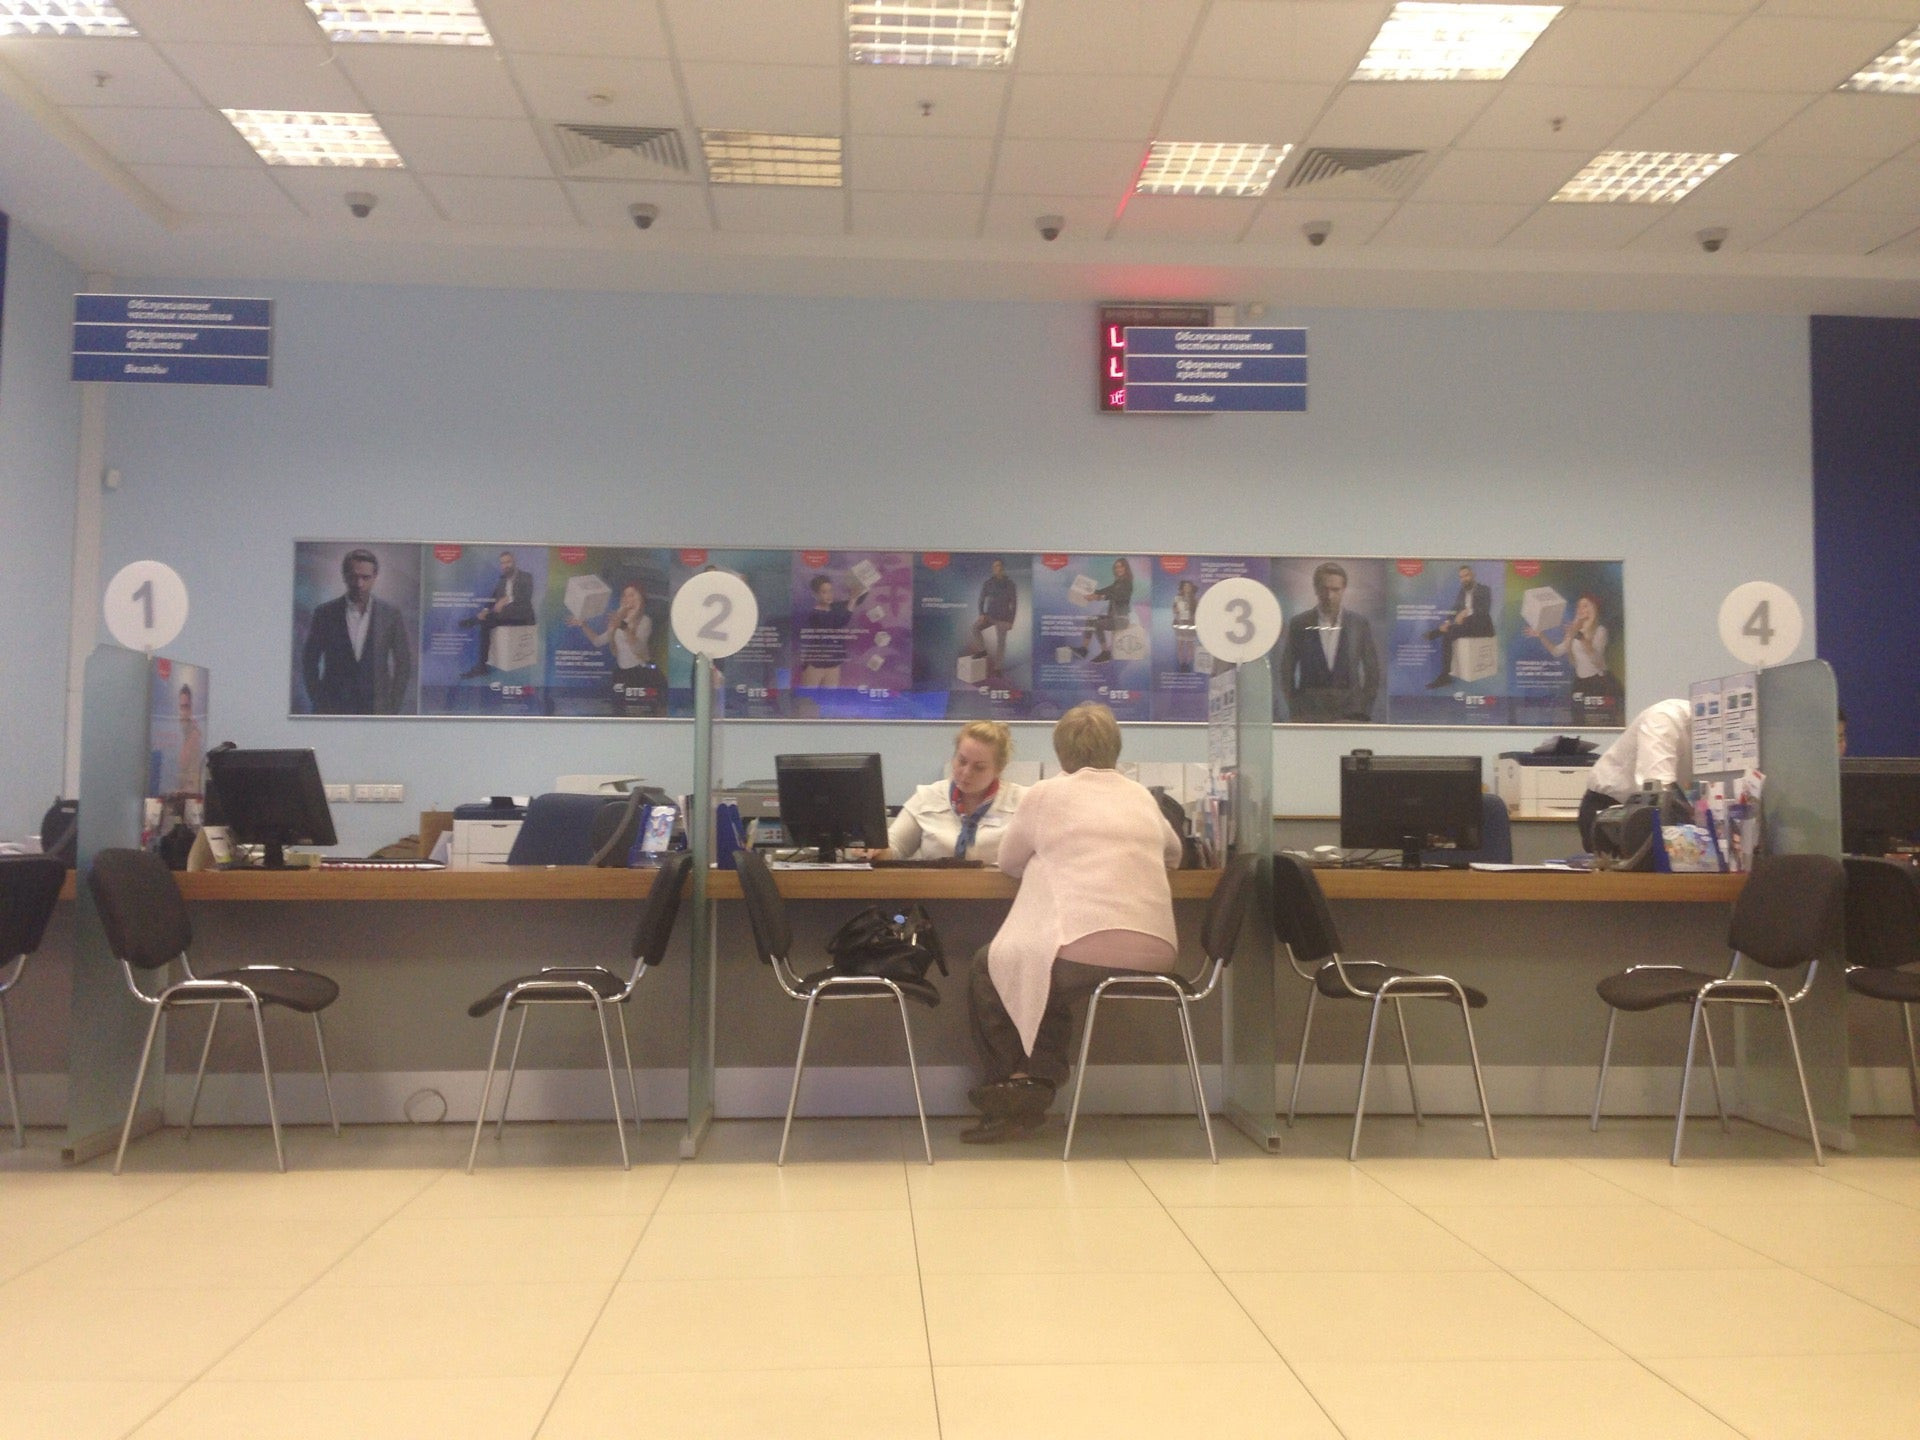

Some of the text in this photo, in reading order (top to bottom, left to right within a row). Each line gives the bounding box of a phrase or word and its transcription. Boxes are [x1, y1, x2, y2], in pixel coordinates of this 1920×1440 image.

[1175, 331, 1252, 343] Обслуживание
[1175, 342, 1274, 351] частных клиентов
[1176, 359, 1243, 372] Оформление
[1176, 370, 1230, 381] кредитов
[1174, 392, 1216, 403] Вклады
[132, 580, 155, 629] 1
[697, 593, 733, 642] 2
[1225, 598, 1255, 645] 3
[1742, 600, 1775, 645] 4
